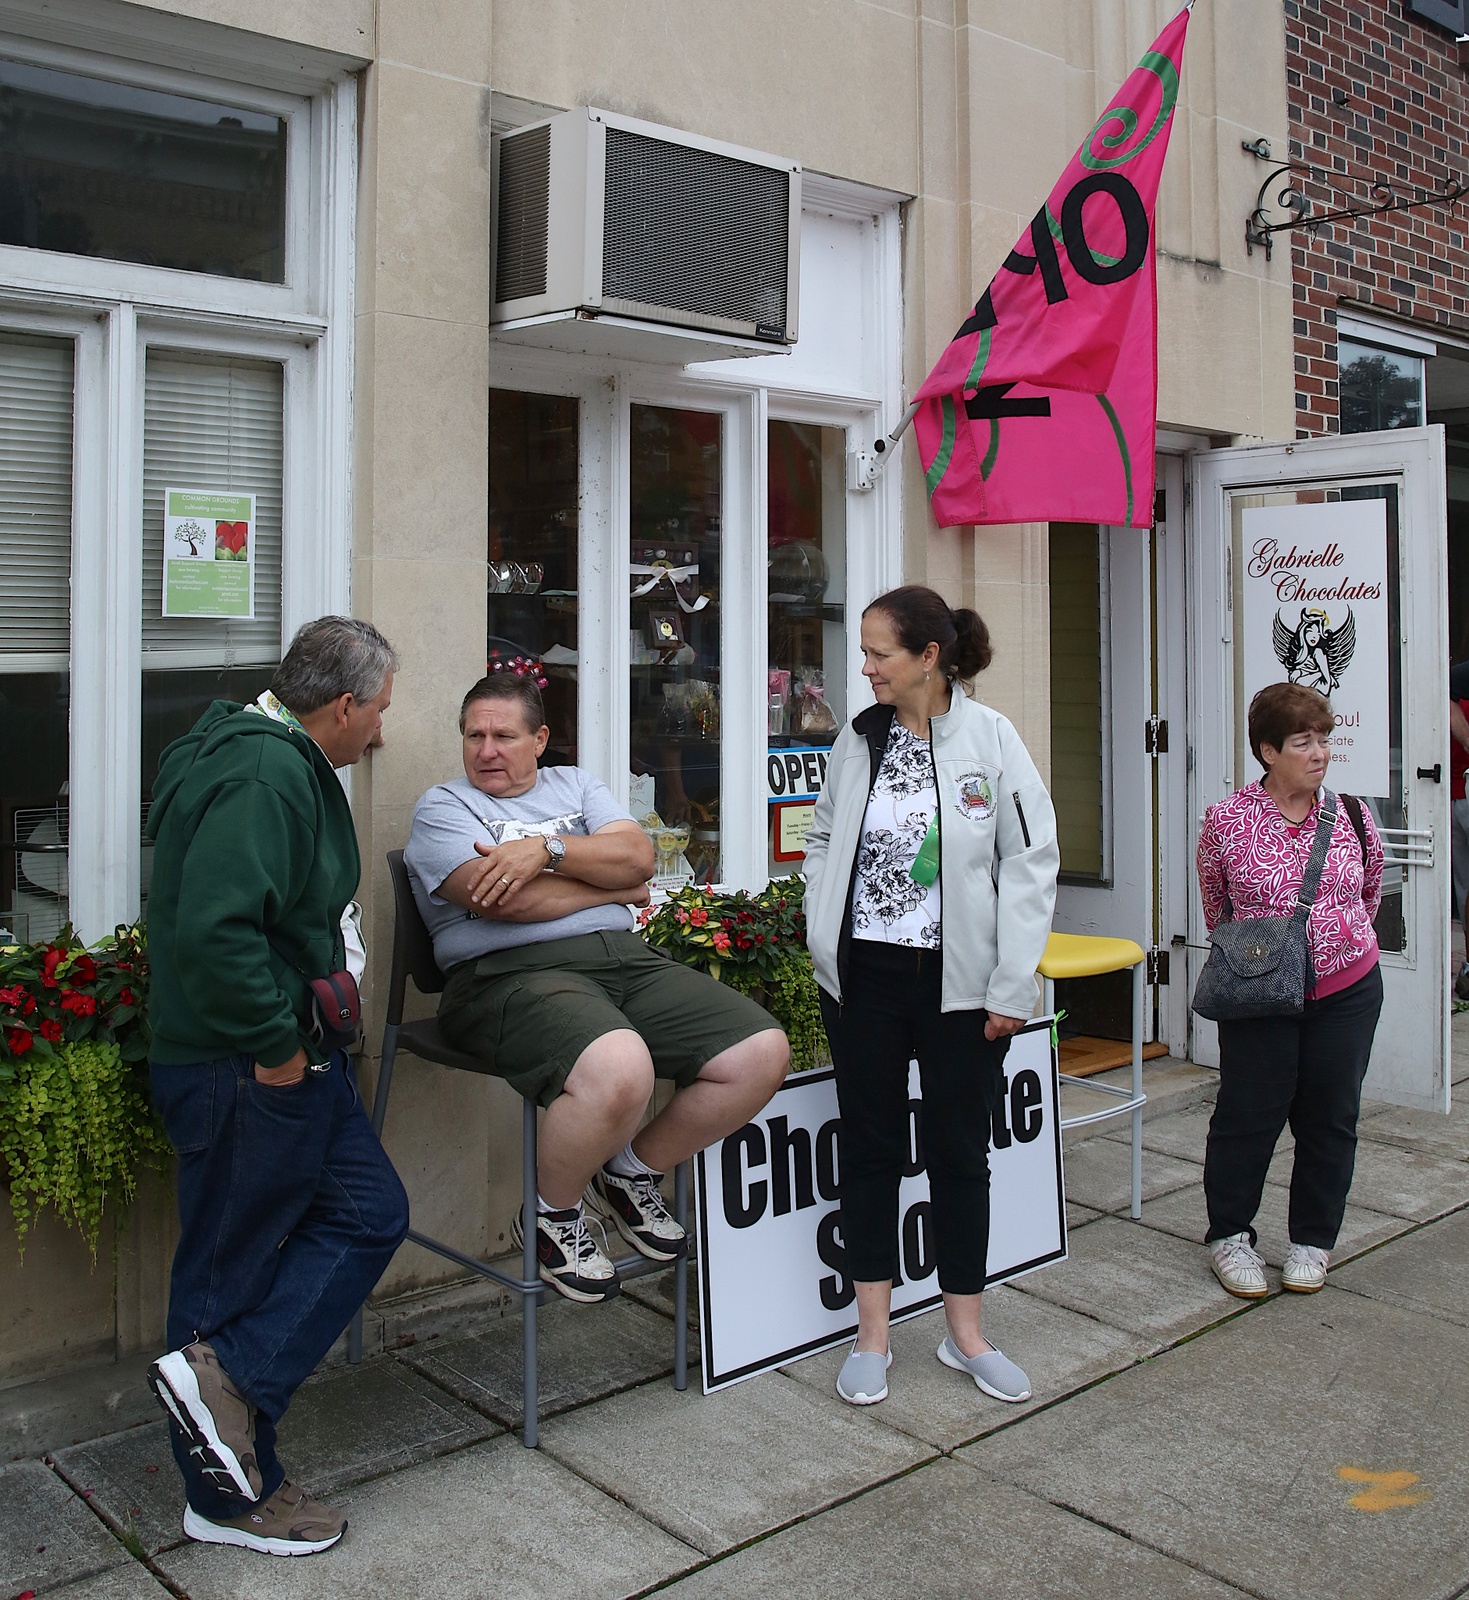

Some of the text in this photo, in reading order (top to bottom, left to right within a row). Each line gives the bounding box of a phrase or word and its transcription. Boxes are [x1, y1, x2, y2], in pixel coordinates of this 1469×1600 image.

[760, 328, 782, 337] Kenmore
[181, 494, 240, 505] COMMON GROUNDS
[184, 503, 237, 514] cultivating community
[1247, 537, 1345, 578] Gabrielle
[1270, 570, 1382, 602] Chocolates
[1333, 711, 1360, 727] ou!
[1328, 735, 1354, 747] ciate
[768, 753, 829, 795] OPEN
[721, 1069, 1043, 1229] Choote
